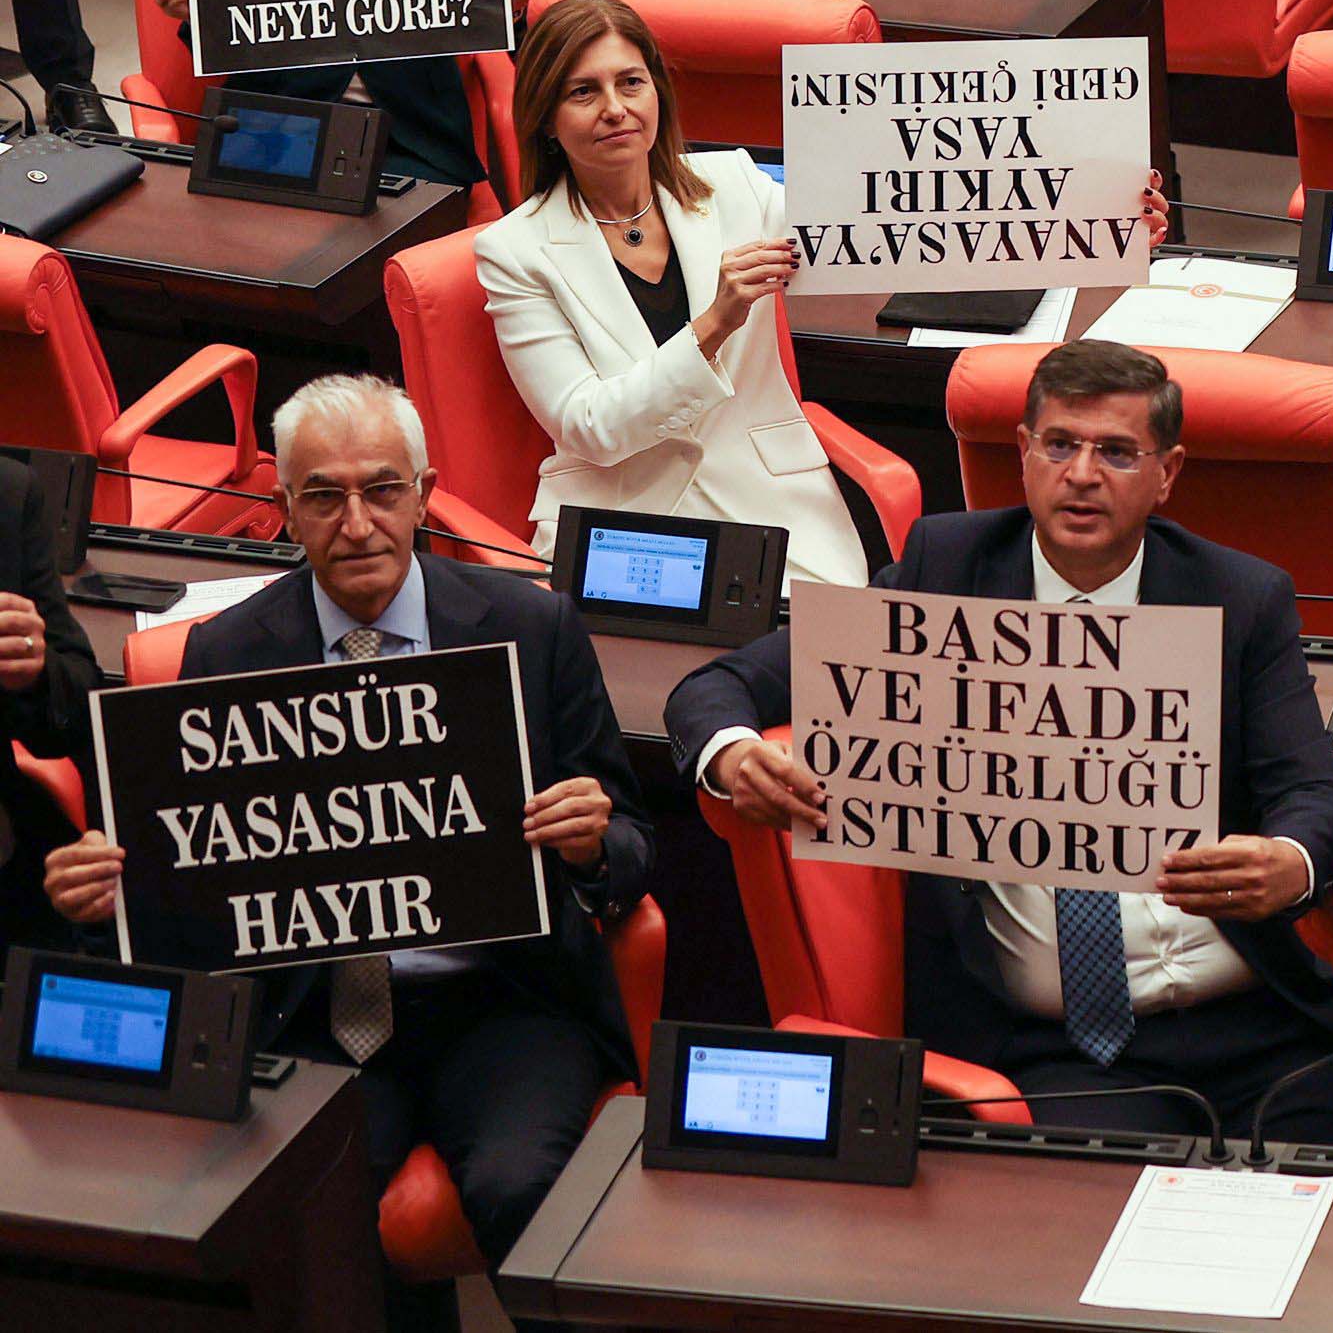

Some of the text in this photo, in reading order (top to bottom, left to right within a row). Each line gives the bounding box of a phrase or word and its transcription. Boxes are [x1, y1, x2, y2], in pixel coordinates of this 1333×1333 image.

[228, 0, 336, 45] NEYE
[790, 60, 1139, 114] GERİ ÇEKİLSİN!
[891, 116, 1043, 161] YASA
[861, 168, 1073, 214] AYKIRI
[881, 600, 1130, 672] BASIN
[179, 672, 447, 772] SANSÜR
[822, 661, 1190, 743] VE İFADE
[804, 719, 1211, 811] ÖZGÜRLÜĞÜ
[156, 774, 486, 868] YASASINA
[228, 875, 441, 957] HAYIR
